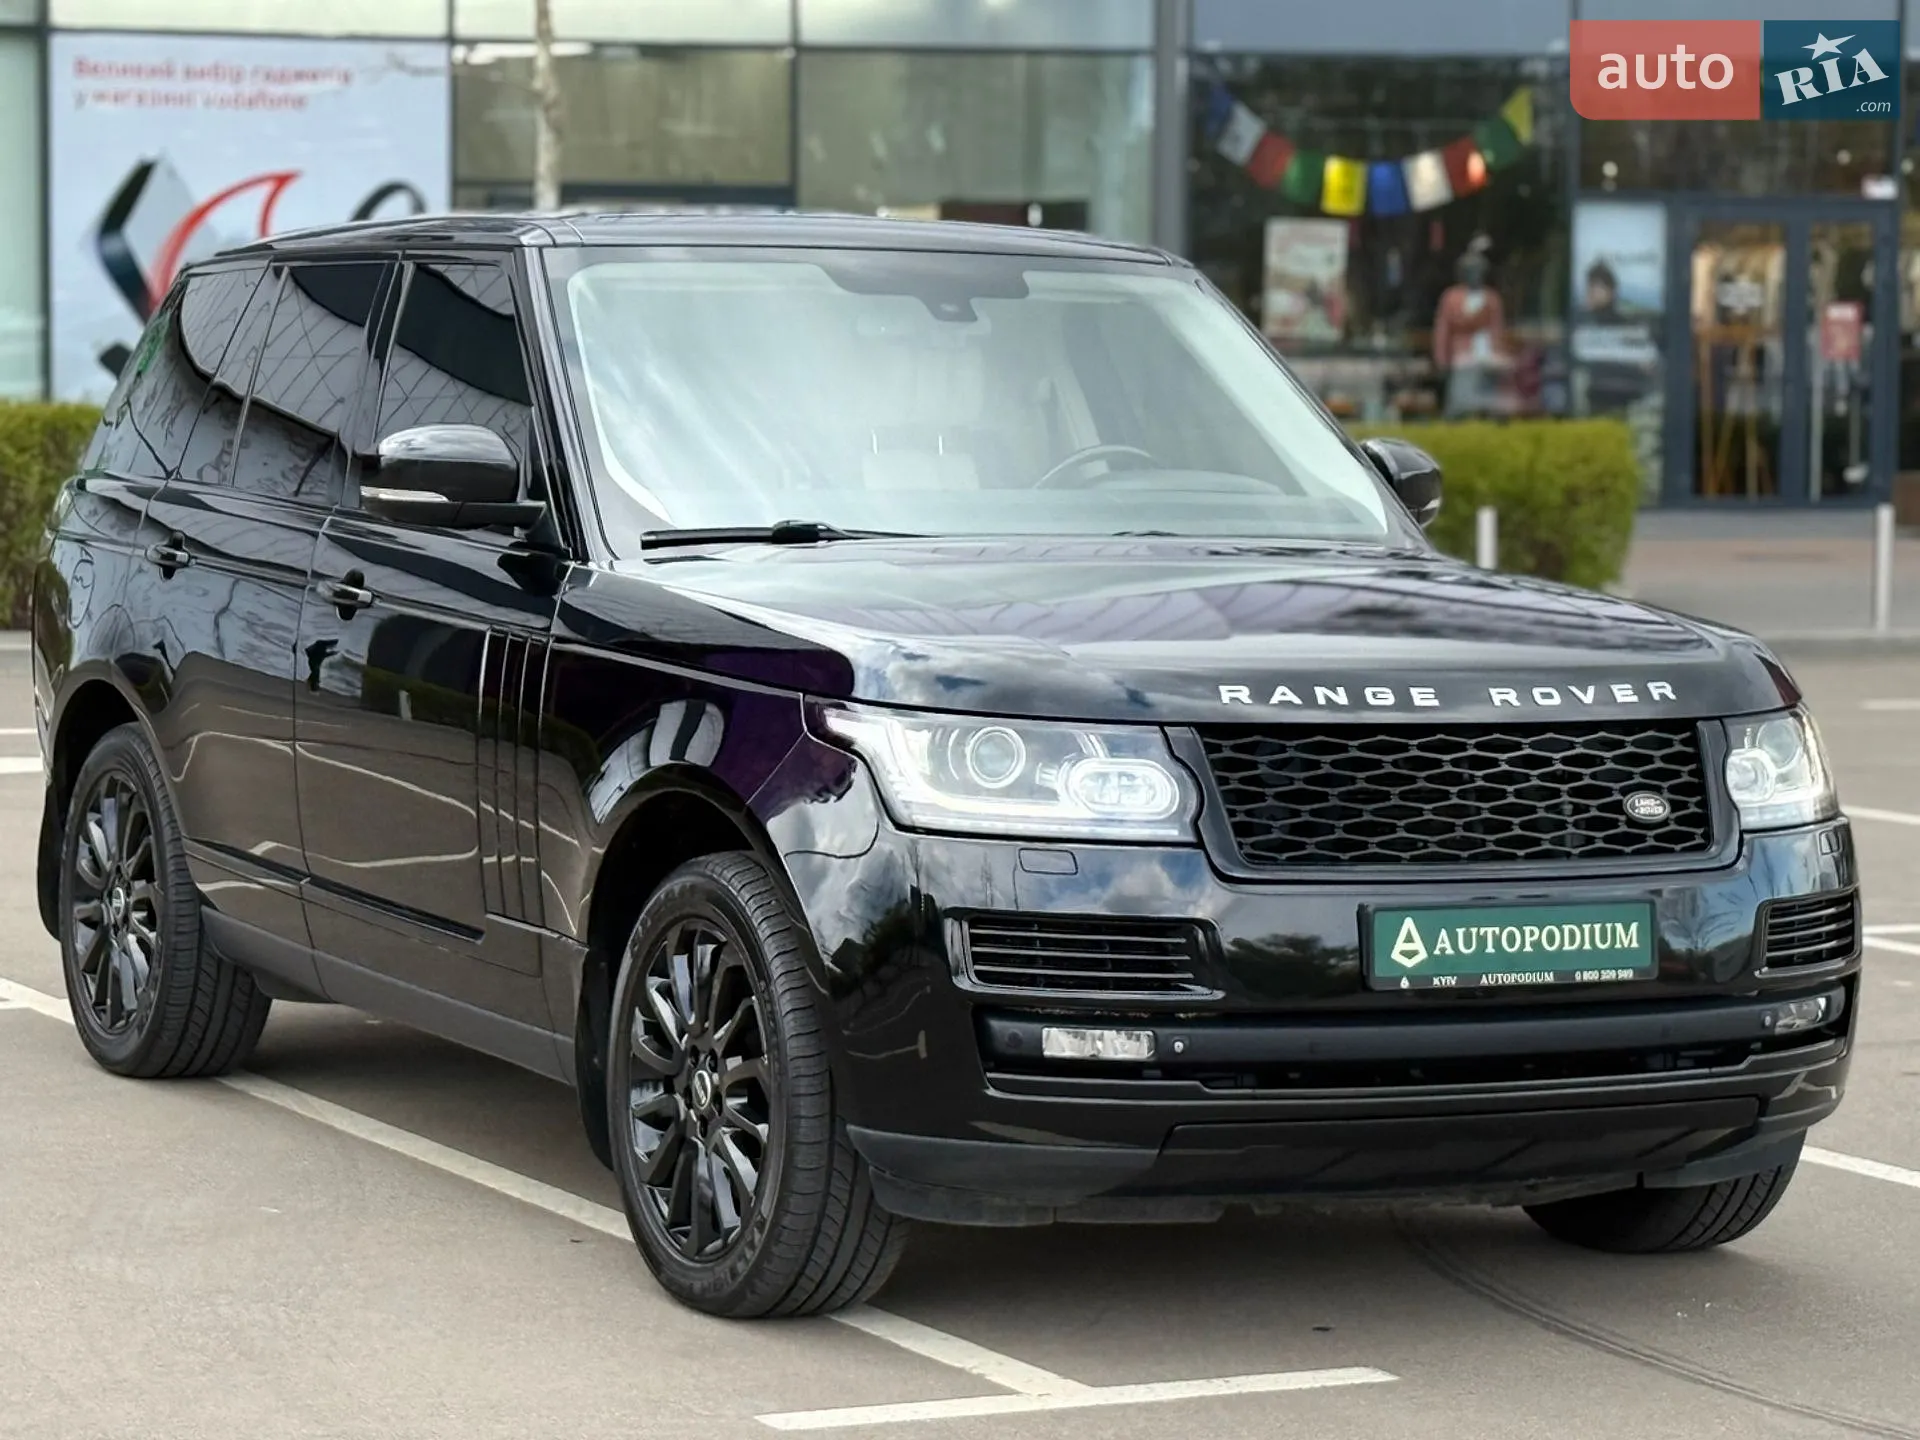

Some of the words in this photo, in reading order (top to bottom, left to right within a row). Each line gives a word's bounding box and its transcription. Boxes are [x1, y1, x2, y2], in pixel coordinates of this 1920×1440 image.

[1218, 685, 1440, 707] RANGE
[1488, 681, 1677, 707] ROVER
[1433, 921, 1639, 956] AUTOPODIUM
[1432, 975, 1457, 987] KYIV
[1480, 971, 1554, 985] AUTOPODIUM
